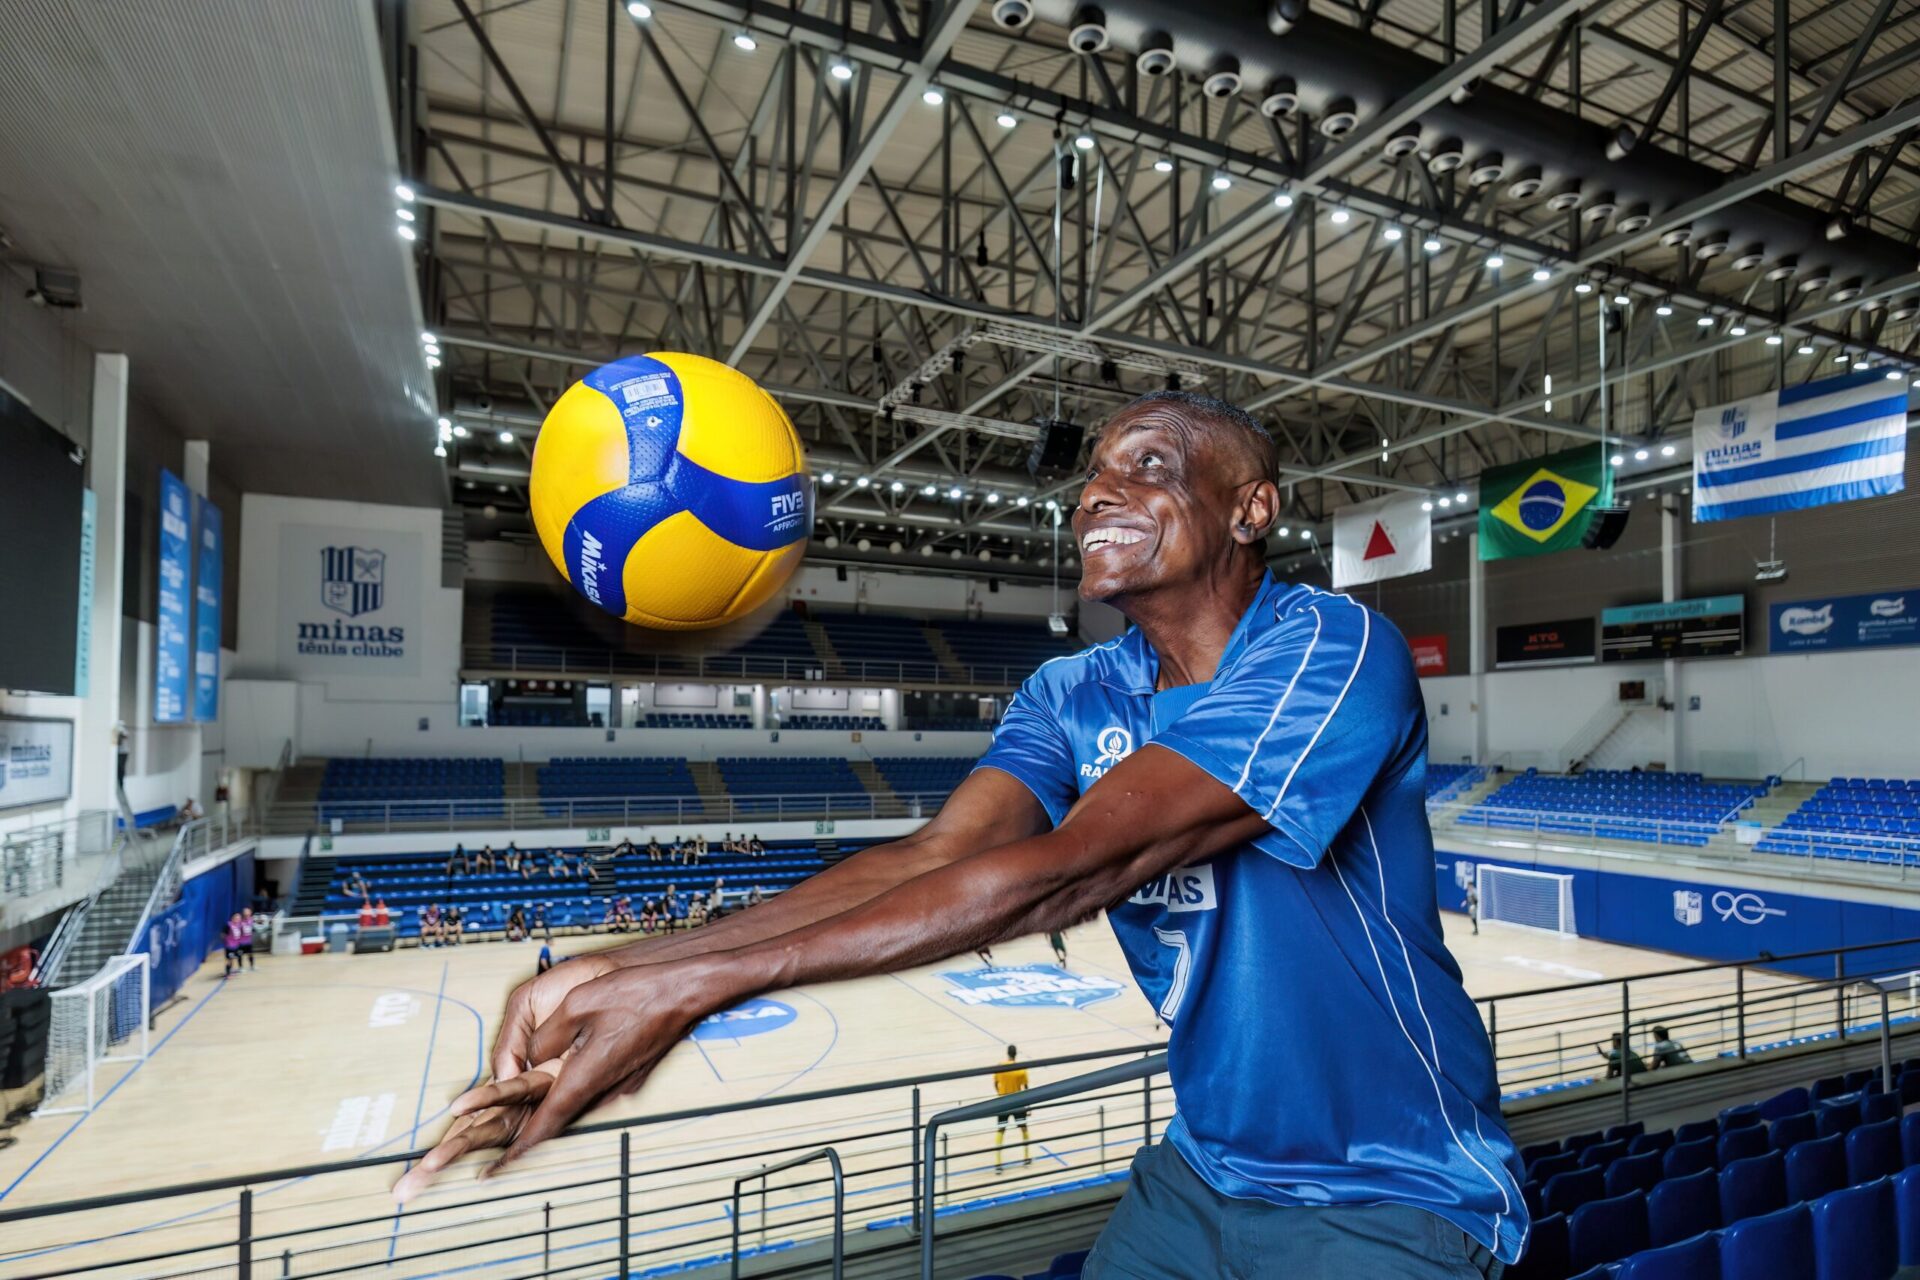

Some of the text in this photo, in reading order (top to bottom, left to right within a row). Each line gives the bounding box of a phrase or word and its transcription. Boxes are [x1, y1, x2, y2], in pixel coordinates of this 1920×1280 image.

[298, 619, 404, 643] minas
[297, 640, 404, 657] tênis clube
[1154, 926, 1190, 1019] 7
